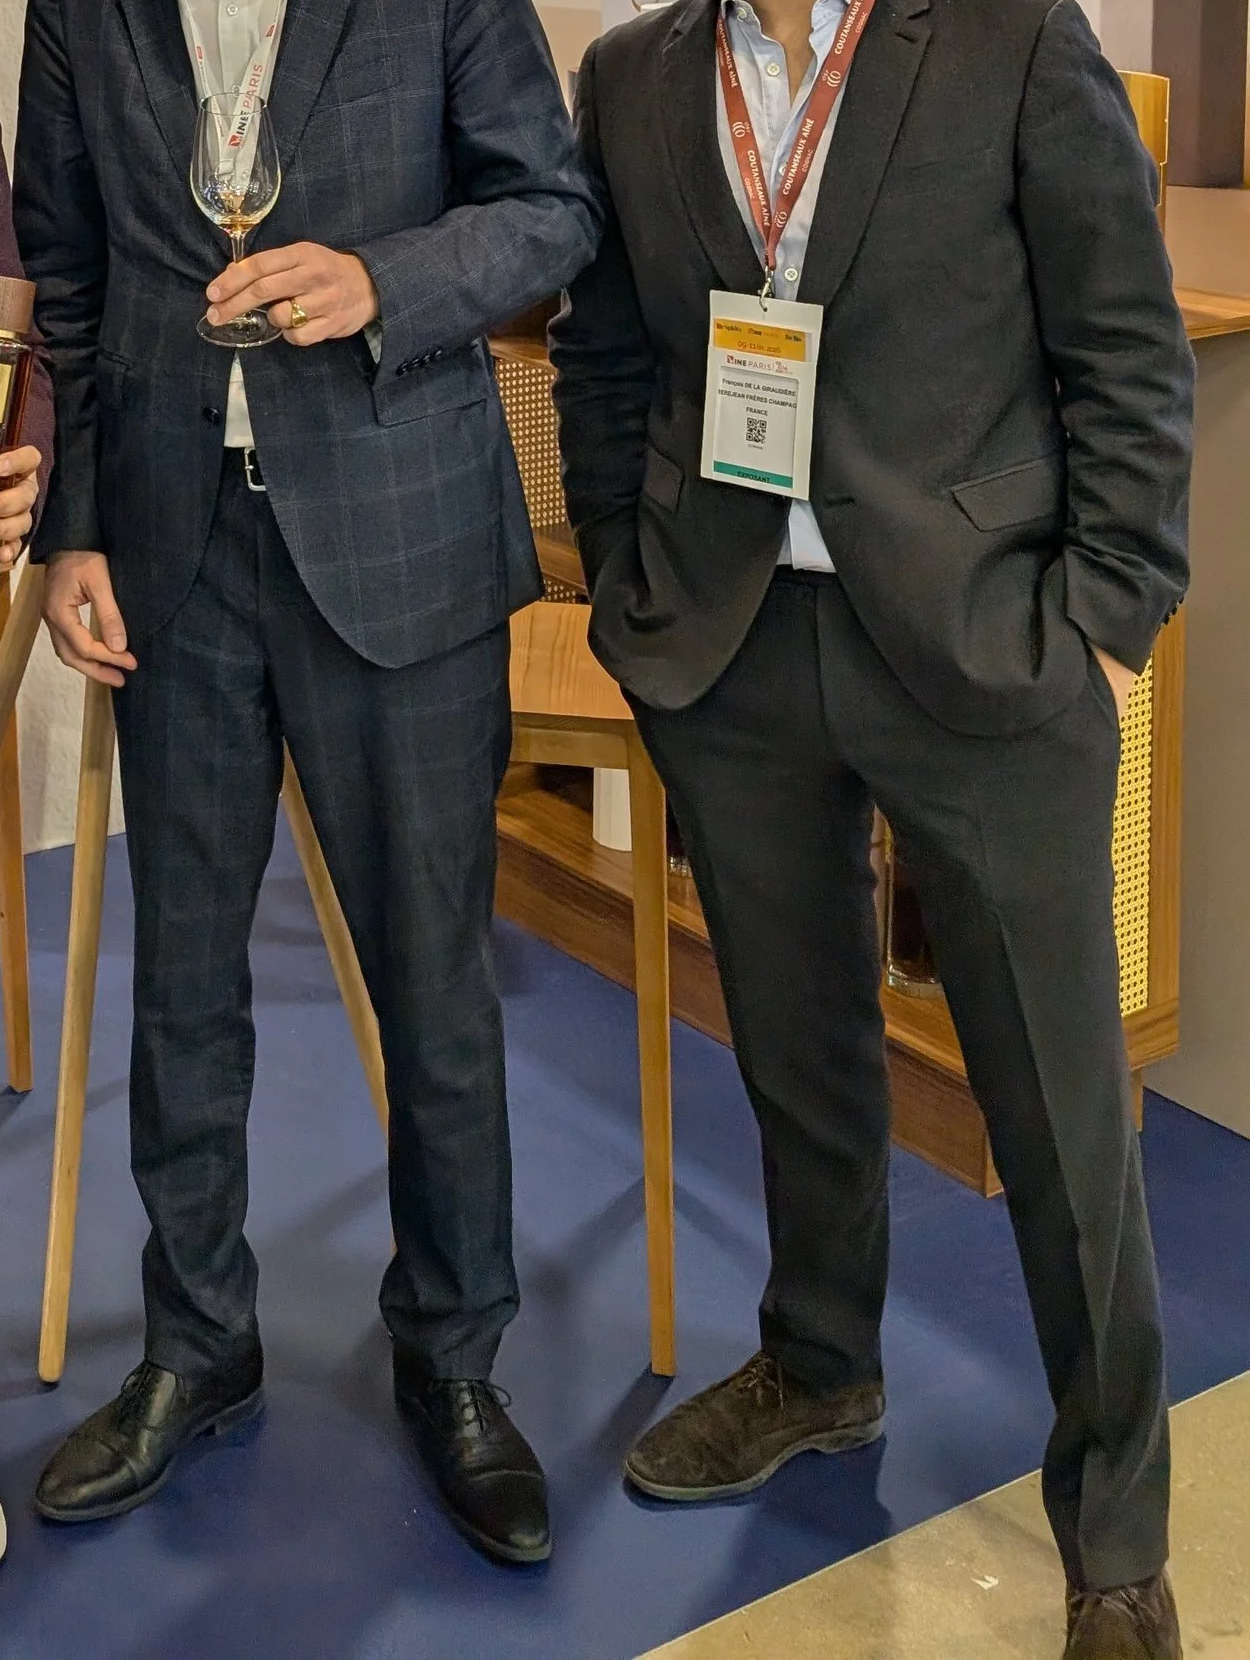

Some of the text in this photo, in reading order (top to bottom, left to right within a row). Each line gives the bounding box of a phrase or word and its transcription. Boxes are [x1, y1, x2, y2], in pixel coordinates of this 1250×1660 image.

[835, 1, 862, 54] COUTANSEAUX
[243, 64, 263, 109] PARIS
[782, 138, 807, 195] COUTANSEAUX
[748, 360, 773, 372] PARIS
[746, 406, 768, 417] FRANCE
